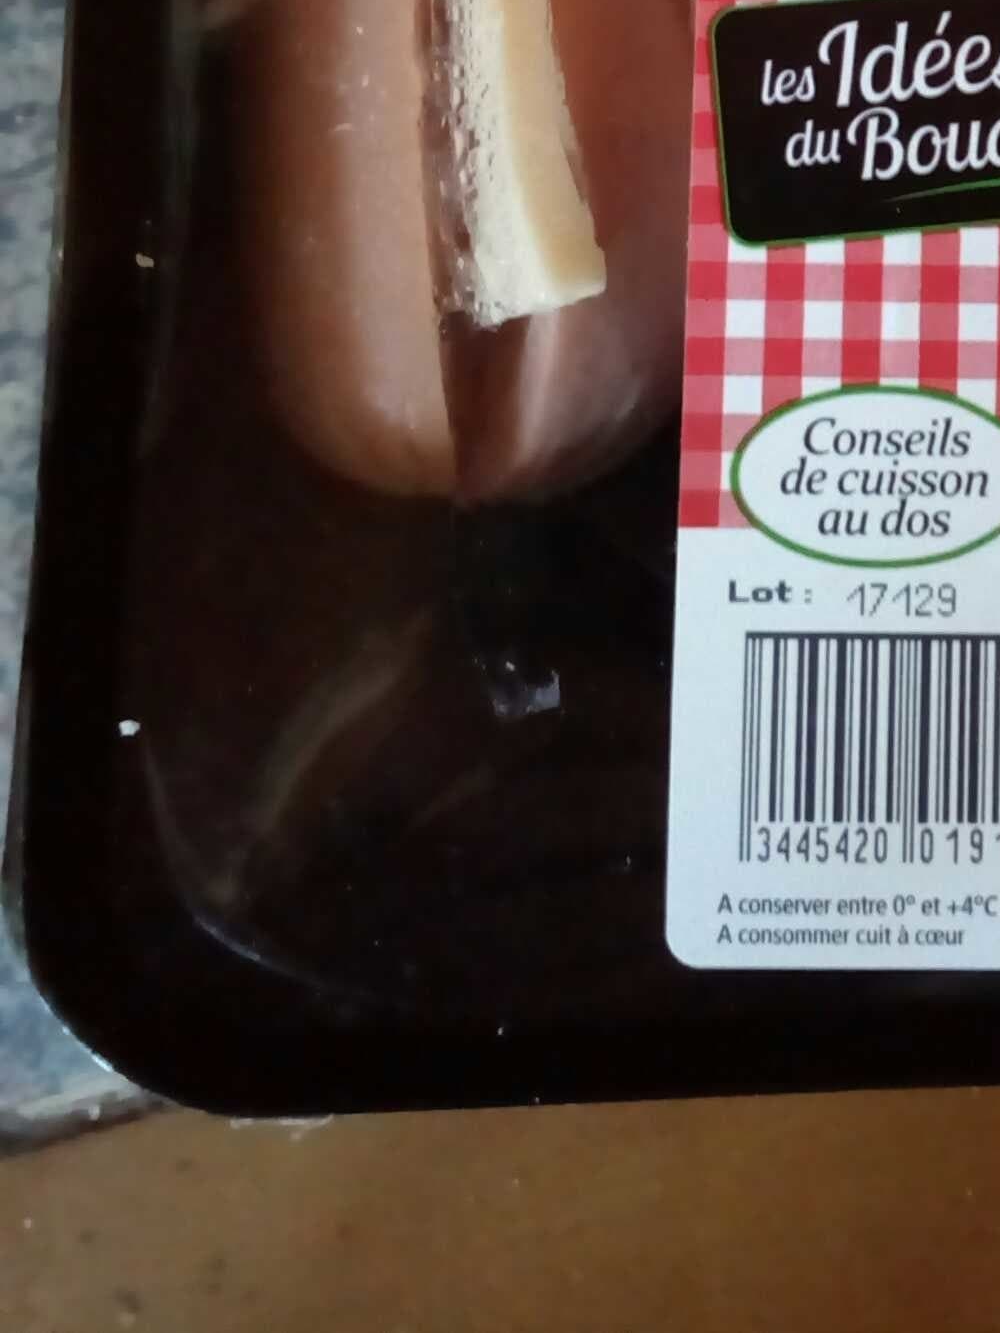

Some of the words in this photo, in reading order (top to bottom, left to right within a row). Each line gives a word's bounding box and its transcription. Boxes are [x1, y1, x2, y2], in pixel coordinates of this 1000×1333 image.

[761, 59, 816, 106] les
[785, 119, 842, 167] du
[803, 417, 971, 457] Conseils
[780, 457, 828, 496] de
[837, 460, 990, 498] cuisson
[817, 509, 868, 536] au
[880, 497, 951, 537] dos
[728, 580, 793, 604] Lot
[847, 583, 958, 617] 17129
[757, 826, 888, 863] 3445420
[716, 894, 733, 916] A
[737, 894, 832, 916] conserver
[836, 895, 888, 917] entre
[920, 896, 941, 917] et
[716, 925, 733, 946] A
[737, 925, 850, 946] consommer
[855, 926, 892, 946] cuit
[896, 927, 910, 946] à
[914, 927, 965, 946] cœur
